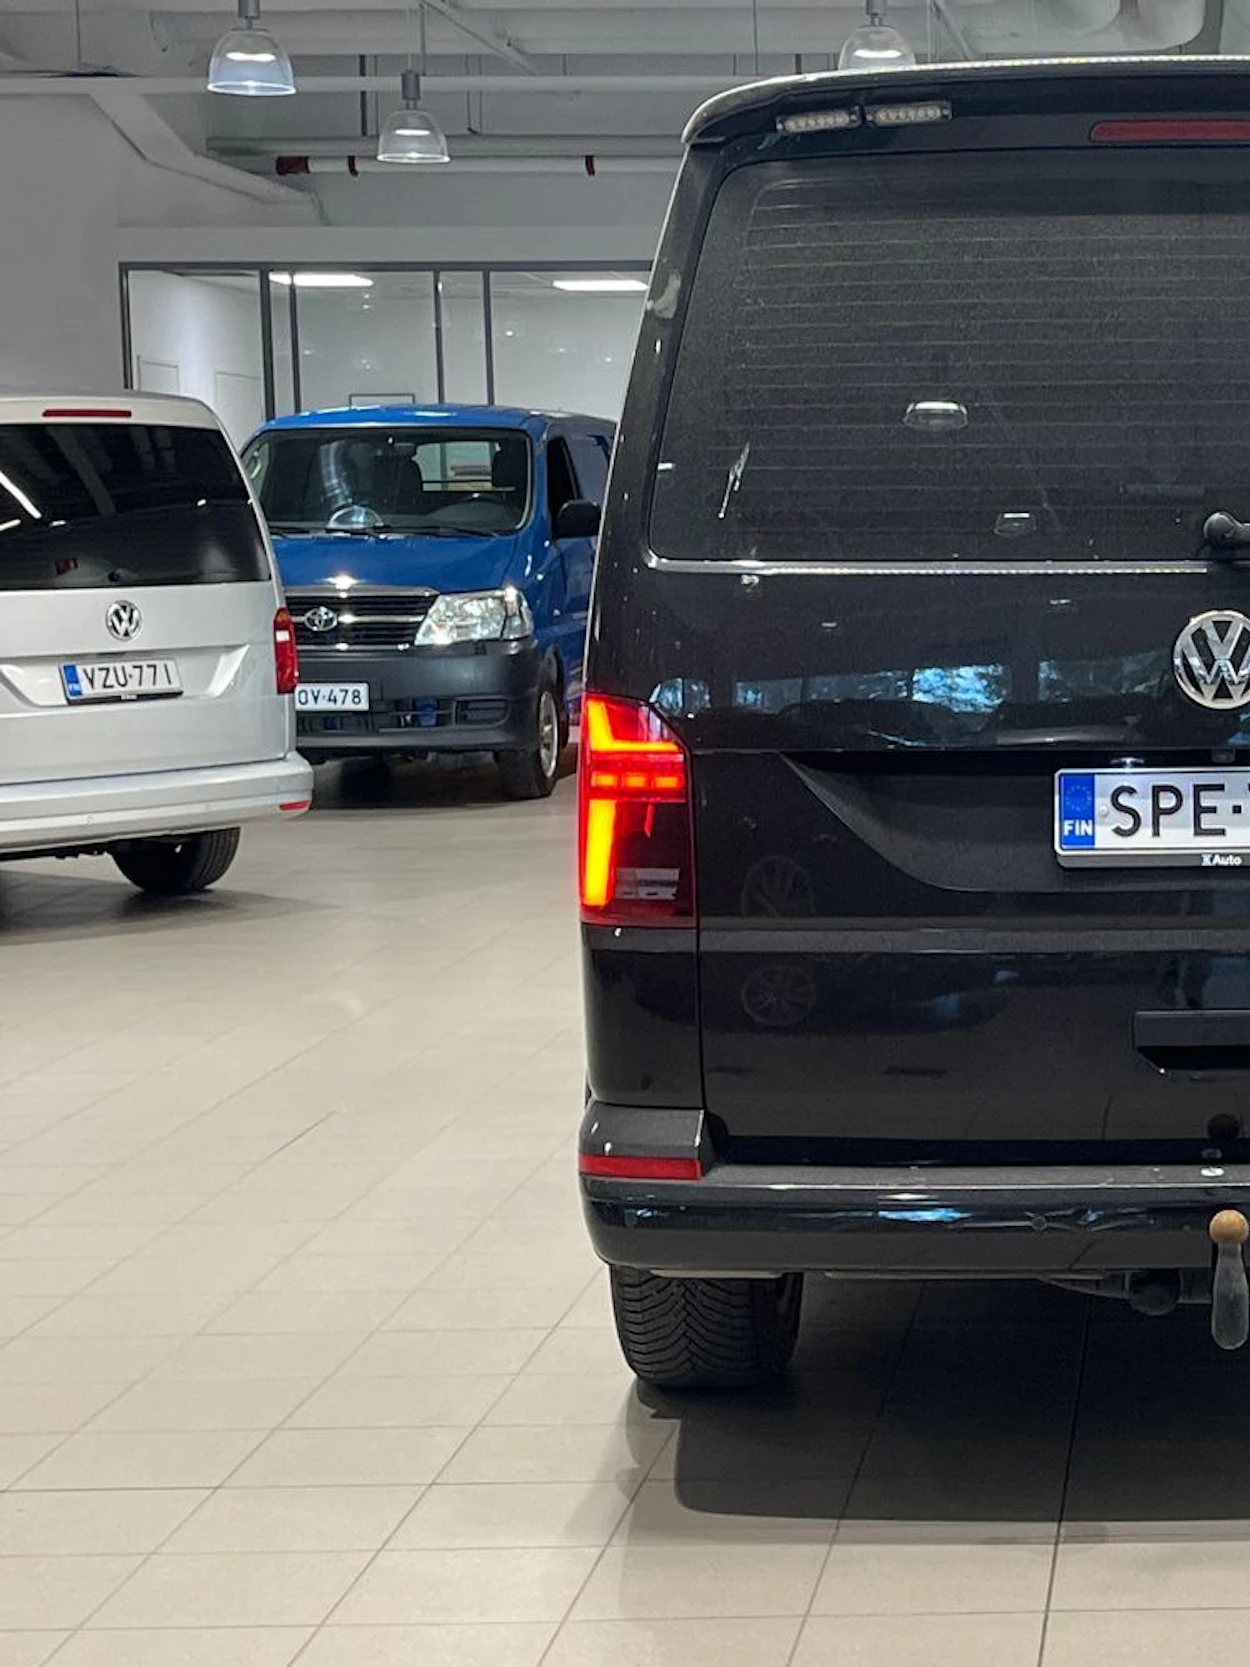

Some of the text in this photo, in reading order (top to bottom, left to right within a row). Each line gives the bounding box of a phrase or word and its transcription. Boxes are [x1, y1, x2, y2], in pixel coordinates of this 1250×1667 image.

[83, 663, 172, 690] VZU-771
[298, 688, 362, 706] OV-478
[1064, 819, 1093, 836] FIN
